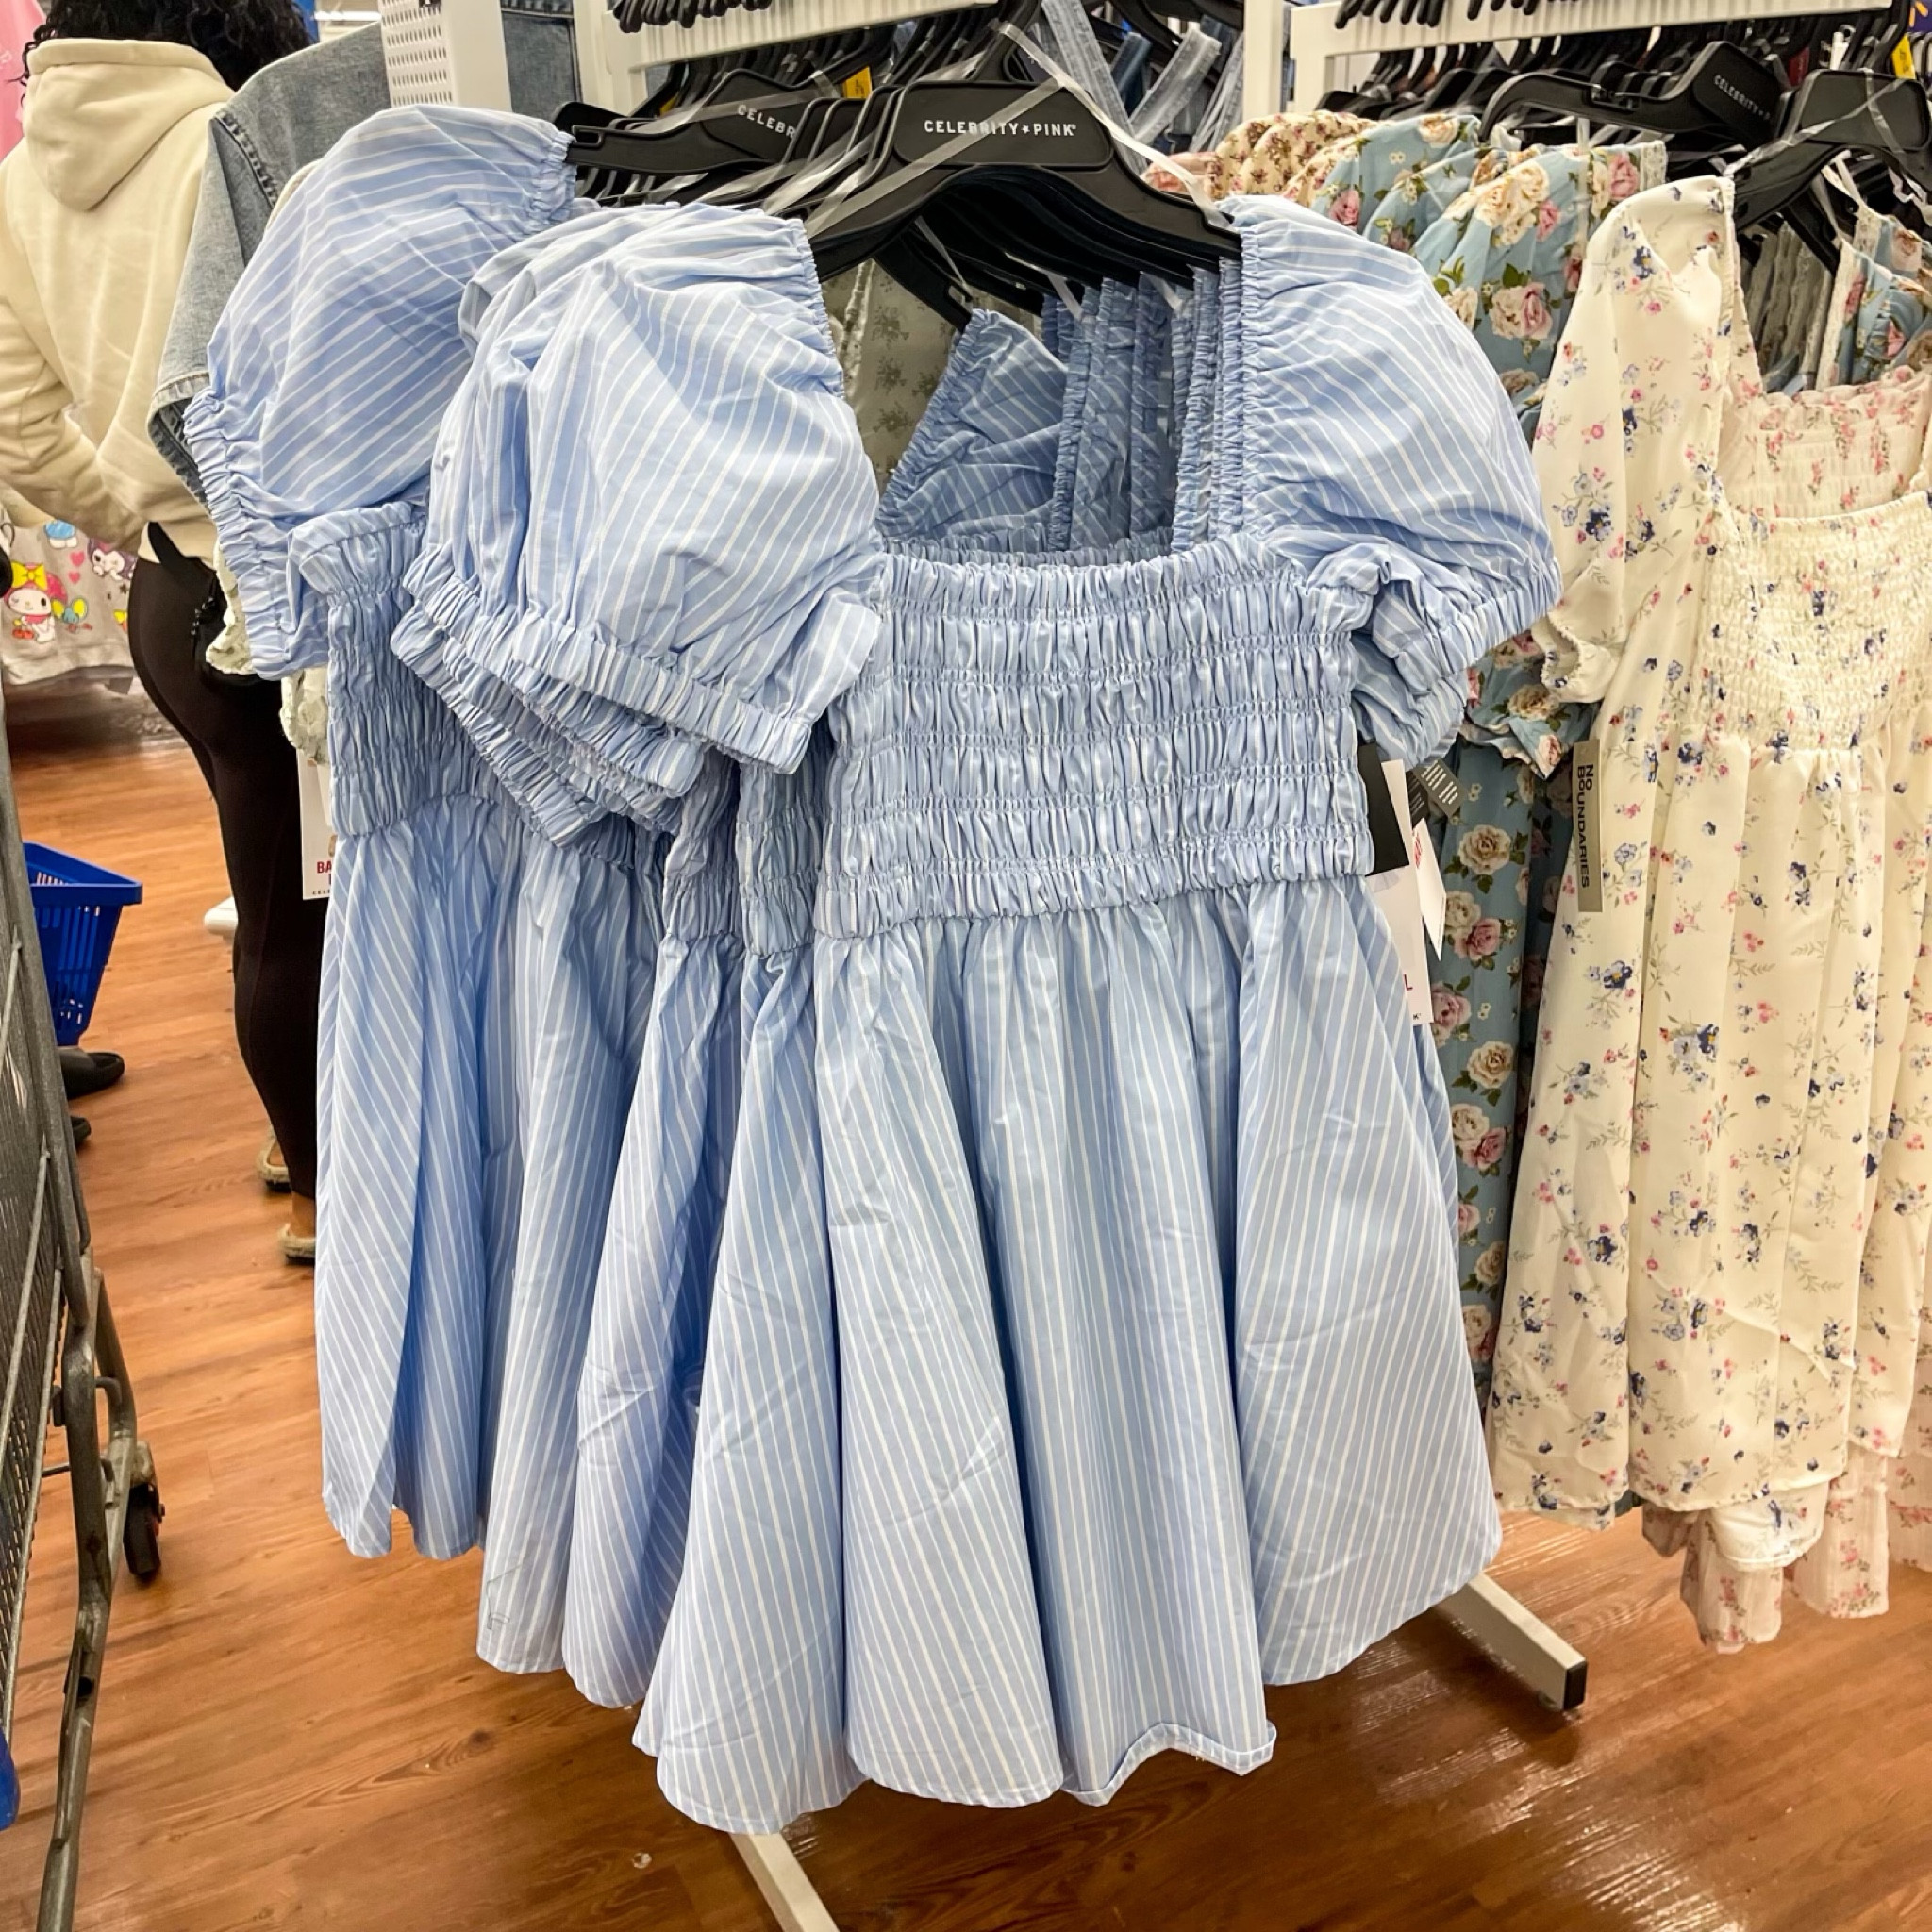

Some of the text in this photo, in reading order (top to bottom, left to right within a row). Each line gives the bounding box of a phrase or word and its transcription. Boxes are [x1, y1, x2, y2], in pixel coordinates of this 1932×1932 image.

[924, 119, 1020, 135] CELEBRITY
[1585, 763, 1595, 791] NO
[1576, 765, 1591, 889] BOUNDARIES
